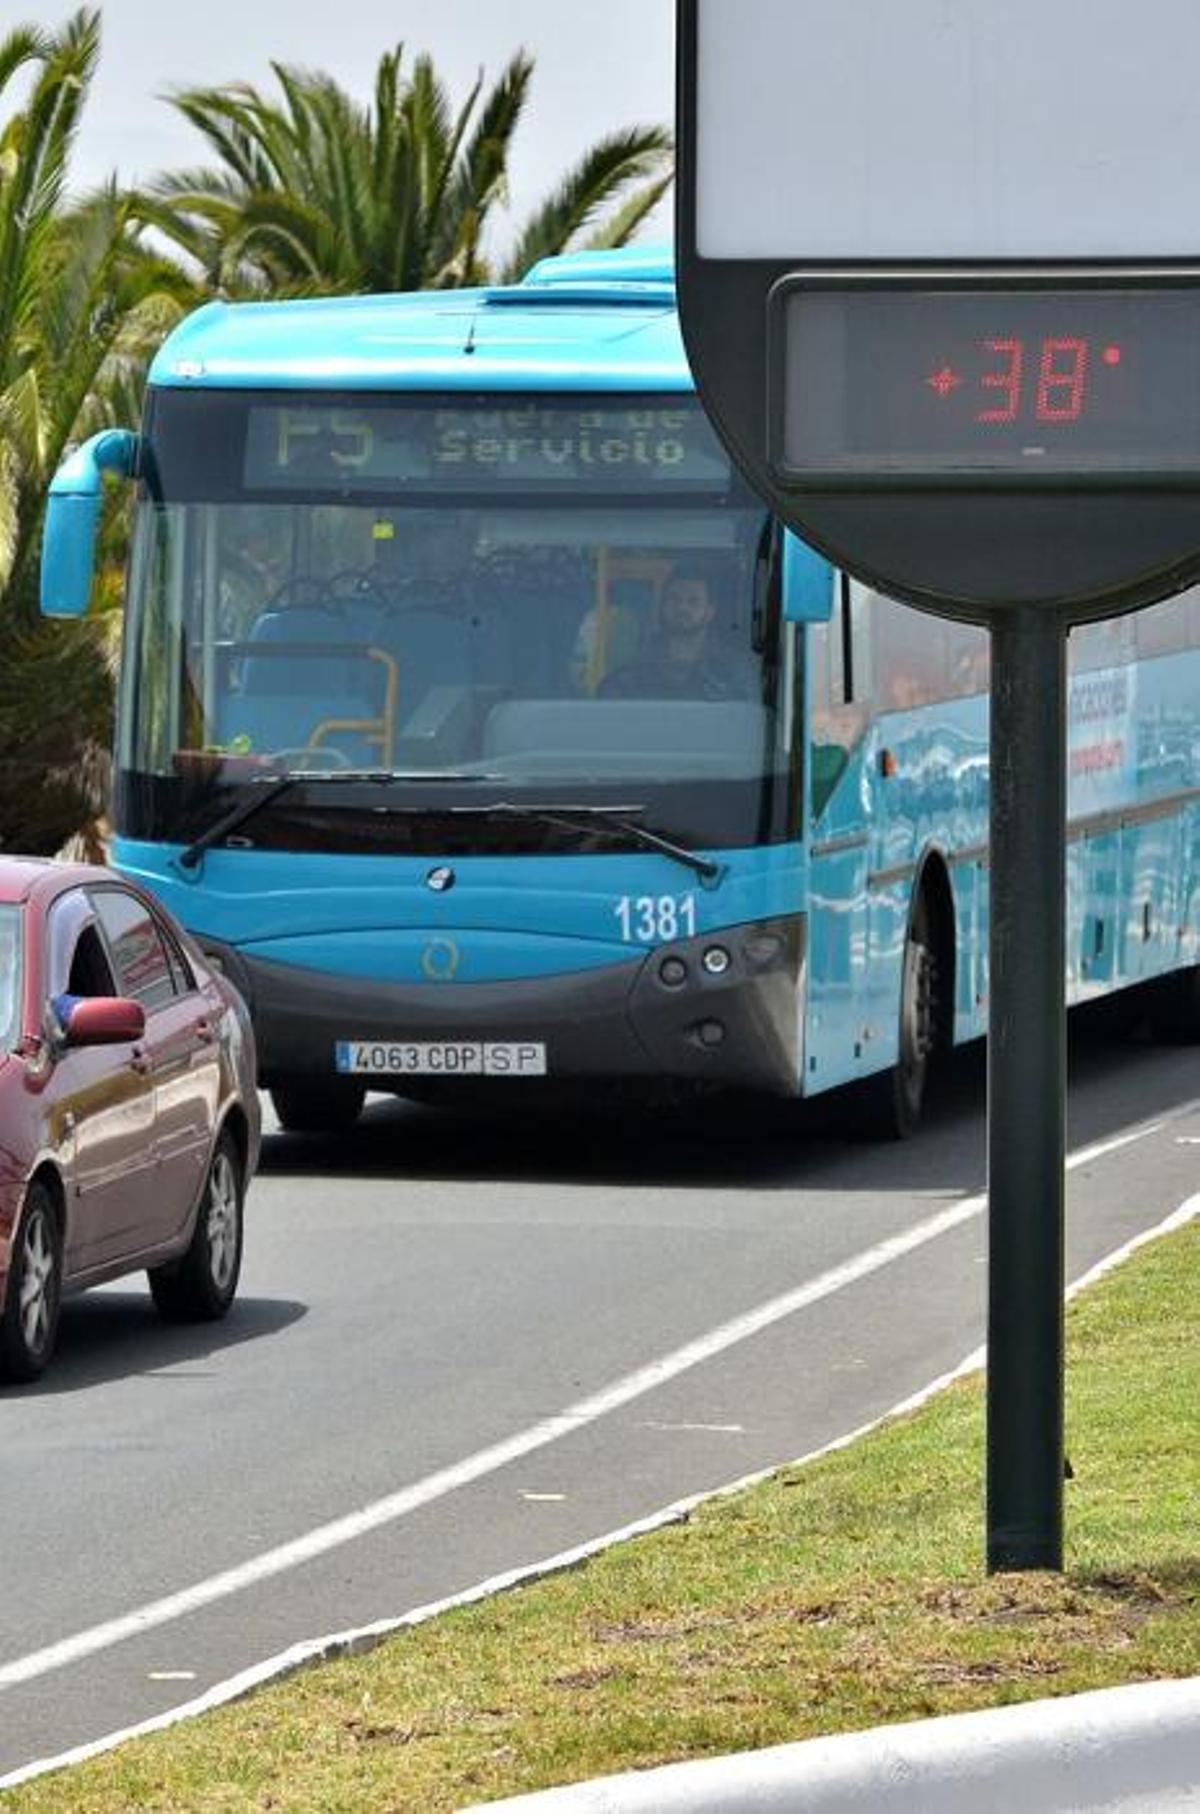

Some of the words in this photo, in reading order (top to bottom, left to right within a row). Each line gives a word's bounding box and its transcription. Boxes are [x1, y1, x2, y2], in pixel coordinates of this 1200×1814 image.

[434, 429, 686, 464] Servicio
[614, 895, 696, 942] 1381
[356, 1046, 418, 1069] 4063
[426, 1046, 477, 1070] CDP
